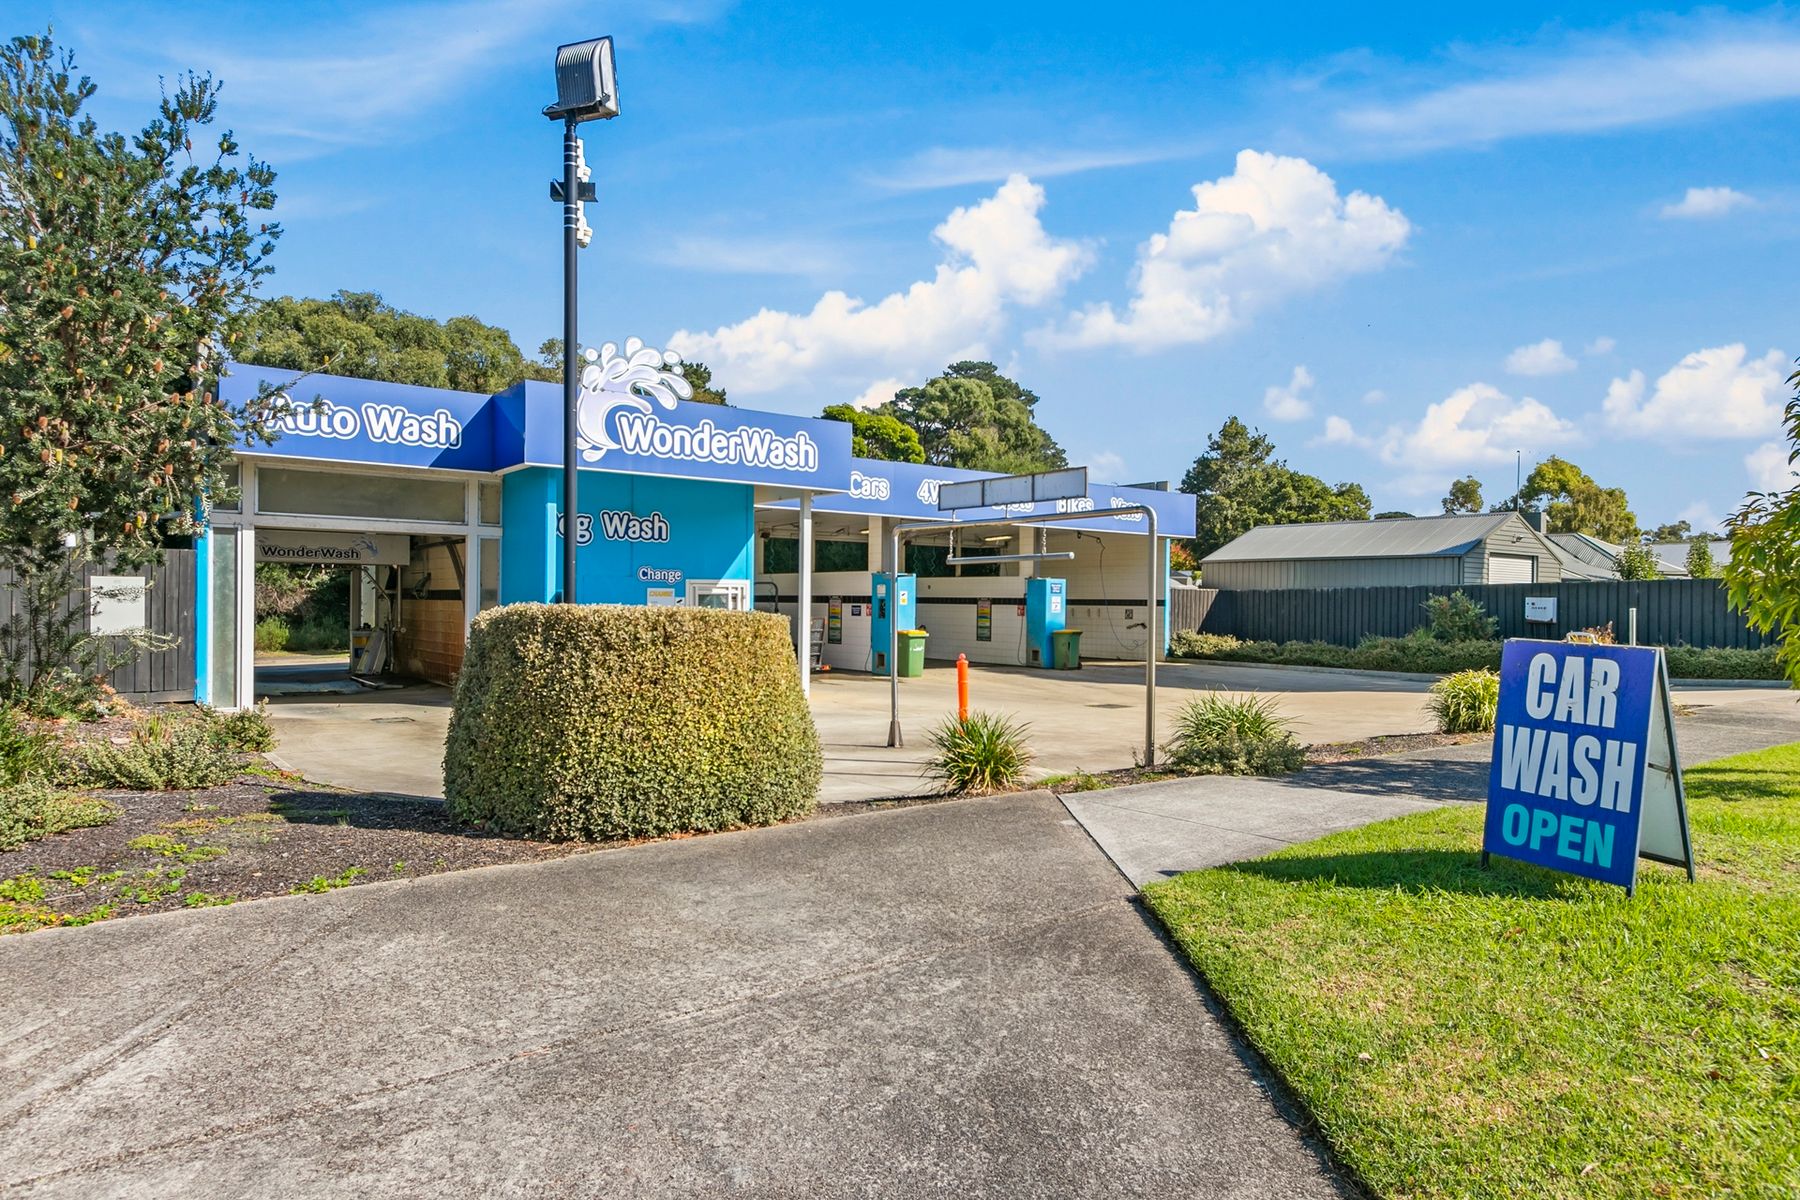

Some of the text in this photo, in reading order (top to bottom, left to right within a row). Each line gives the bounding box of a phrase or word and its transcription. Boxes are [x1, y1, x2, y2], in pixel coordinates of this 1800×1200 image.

[362, 403, 461, 448] Wash
[616, 412, 818, 472] WonderWash
[850, 471, 889, 500] Cars
[601, 510, 669, 542] Wash
[261, 545, 360, 559] WonderWash
[638, 566, 682, 584] Change
[1526, 653, 1620, 728] CAR
[1501, 724, 1637, 813] WASH
[1502, 804, 1615, 868] OPEN
